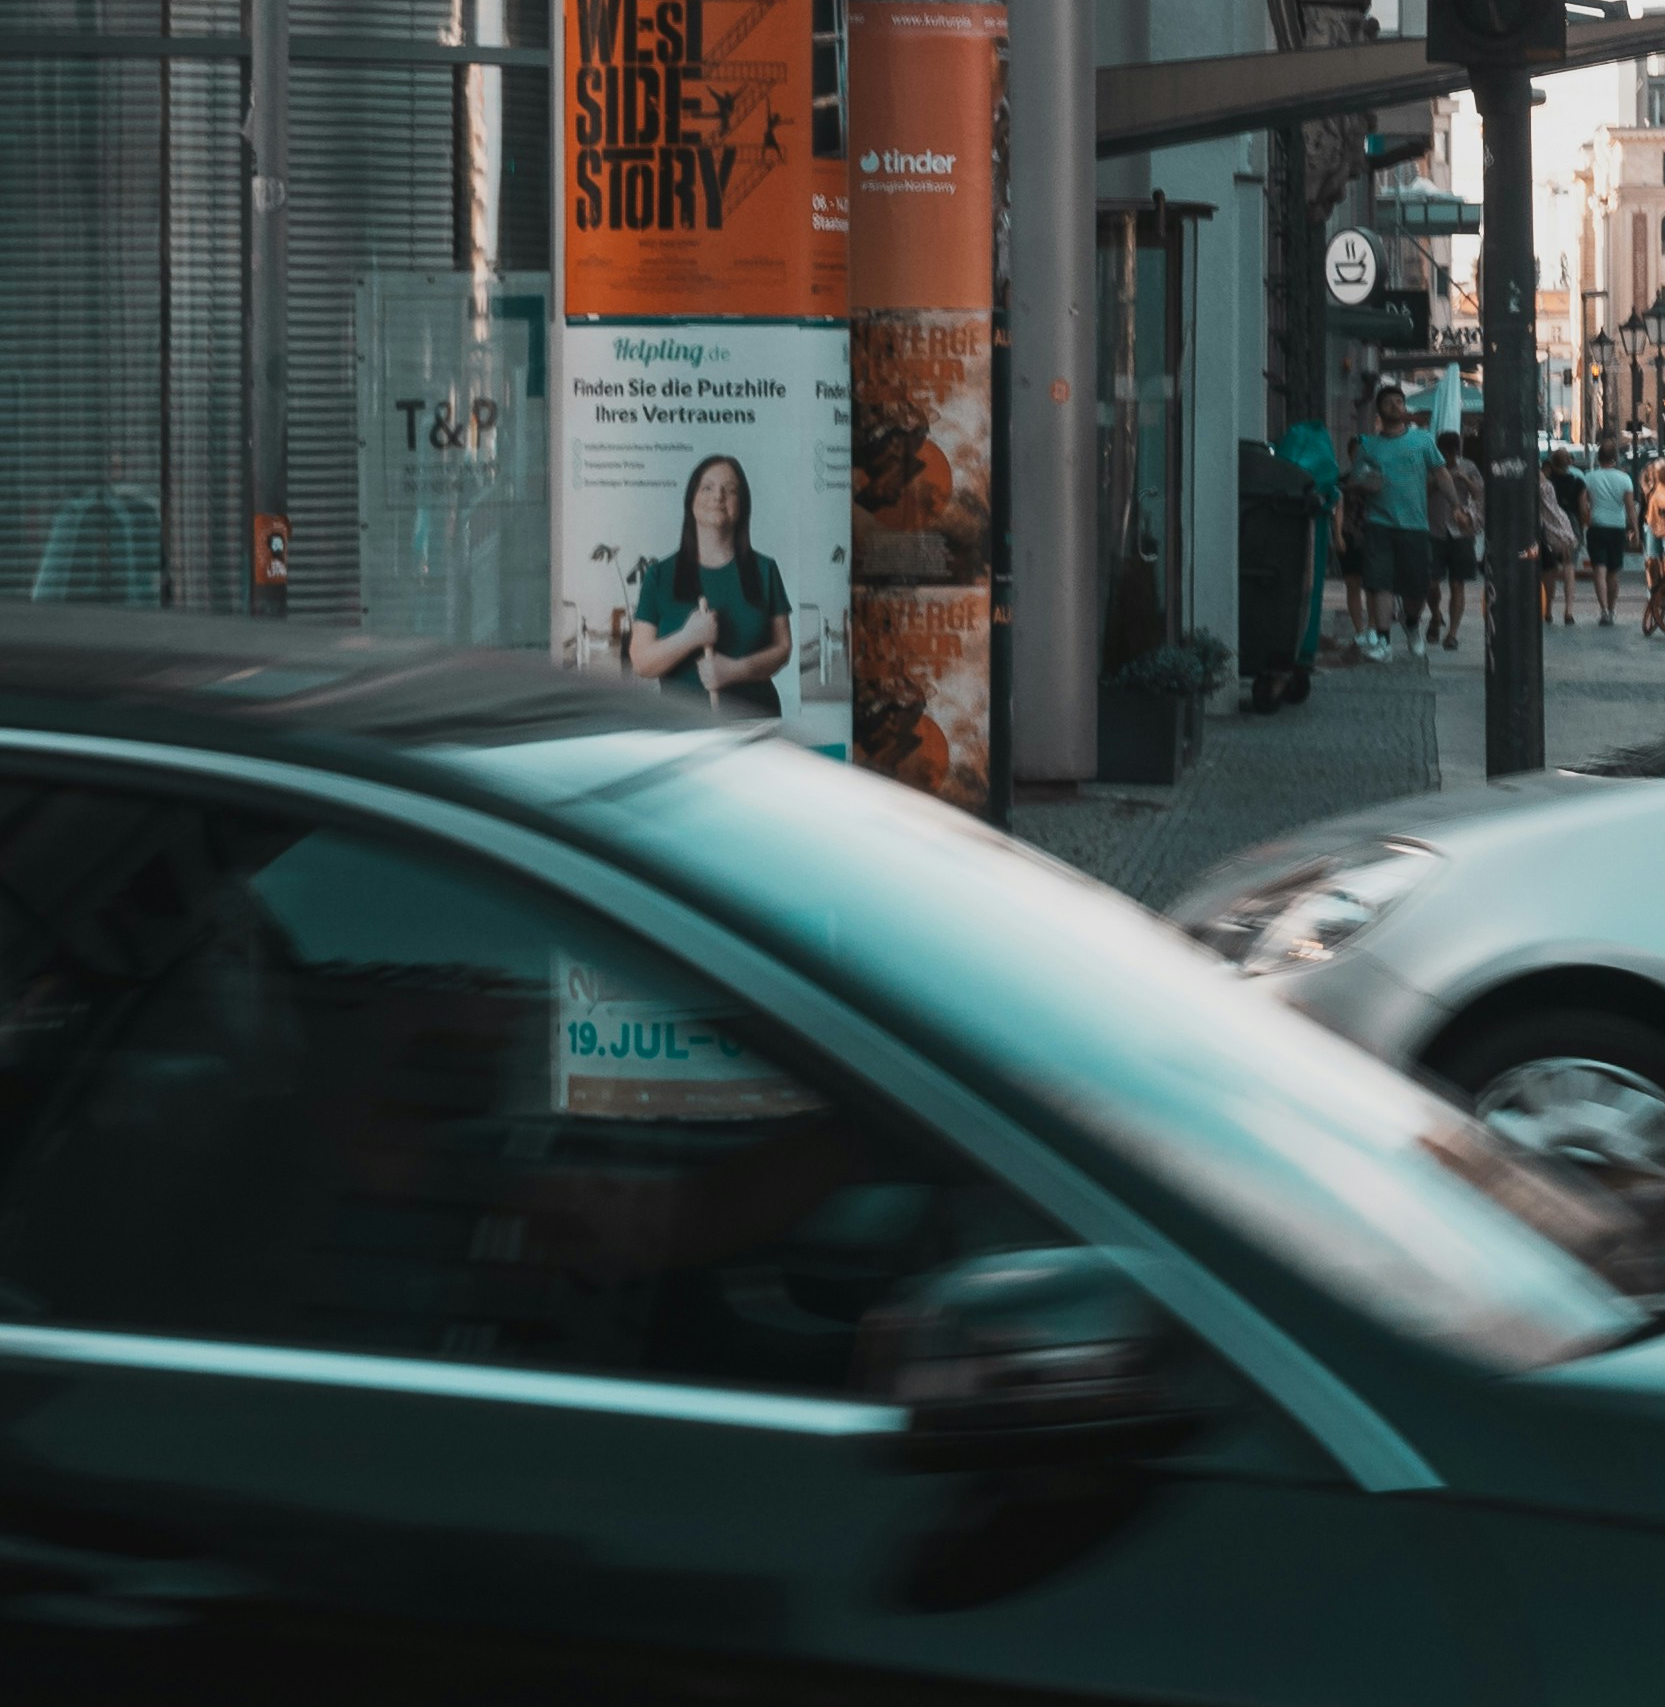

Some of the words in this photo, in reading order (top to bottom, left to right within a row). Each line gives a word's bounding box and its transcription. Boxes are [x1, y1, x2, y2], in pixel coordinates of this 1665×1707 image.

[576, 66, 700, 145] SIDE
[883, 149, 957, 174] tinder
[576, 147, 737, 232] STORY
[613, 336, 731, 369] Helpling.de
[573, 378, 625, 398] Finden
[628, 378, 656, 398] Sie
[661, 378, 693, 398] die
[698, 378, 787, 399] Putzhilfe
[396, 398, 498, 451] T&P
[596, 405, 639, 424] Ihres
[642, 404, 756, 424] Vertrauens
